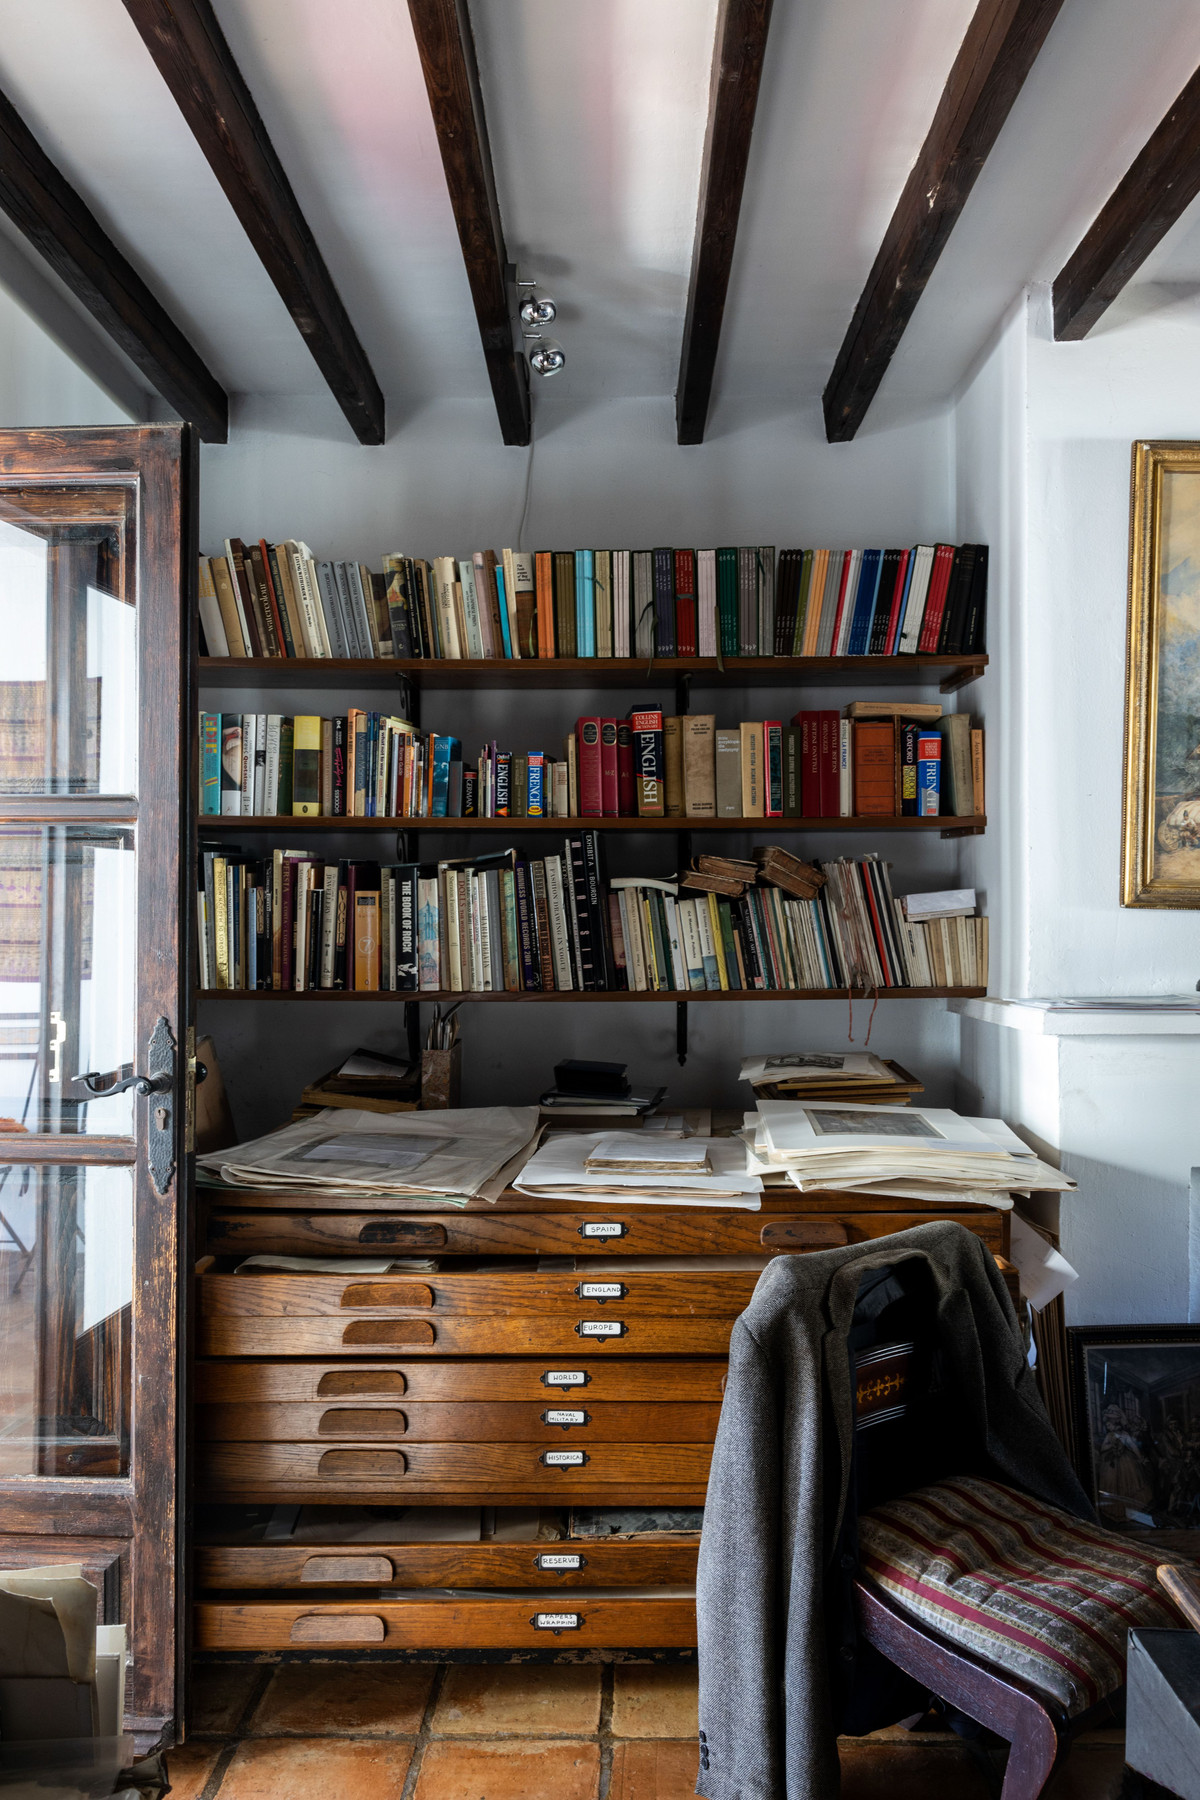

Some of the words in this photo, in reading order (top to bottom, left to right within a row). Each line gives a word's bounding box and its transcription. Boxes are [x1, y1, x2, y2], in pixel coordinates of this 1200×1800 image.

[294, 556, 303, 571] LIVING
[259, 582, 274, 632] watercolour
[206, 716, 218, 754] EDIE
[358, 733, 367, 759] Marilyn
[906, 735, 914, 764] OXFORD
[640, 733, 658, 804] ENGLISH
[465, 779, 473, 808] GERMAN
[497, 764, 509, 805] ENGLISH
[529, 767, 541, 806] FRENCH
[926, 762, 937, 807] FRENCH
[282, 859, 290, 893] PERSIA
[402, 880, 412, 897] THE
[516, 867, 526, 898] GUINNESS
[549, 868, 558, 900] FASHION
[589, 876, 597, 905] BOURDIN
[325, 874, 333, 914] JEWELLERY
[382, 873, 390, 912] MONROE
[458, 880, 467, 908] DOLLS
[402, 897, 412, 919] BOOK
[519, 899, 528, 921] WORLD
[553, 901, 562, 936] DRAWING
[402, 920, 412, 930] OF
[521, 922, 530, 949] RECORDS
[402, 931, 412, 953] ROCK
[557, 937, 563, 945] IN
[524, 950, 532, 966] 2001
[558, 947, 566, 973] VOGUE
[583, 1324, 614, 1332] EUROPE
[542, 1557, 581, 1565] RESERVED
